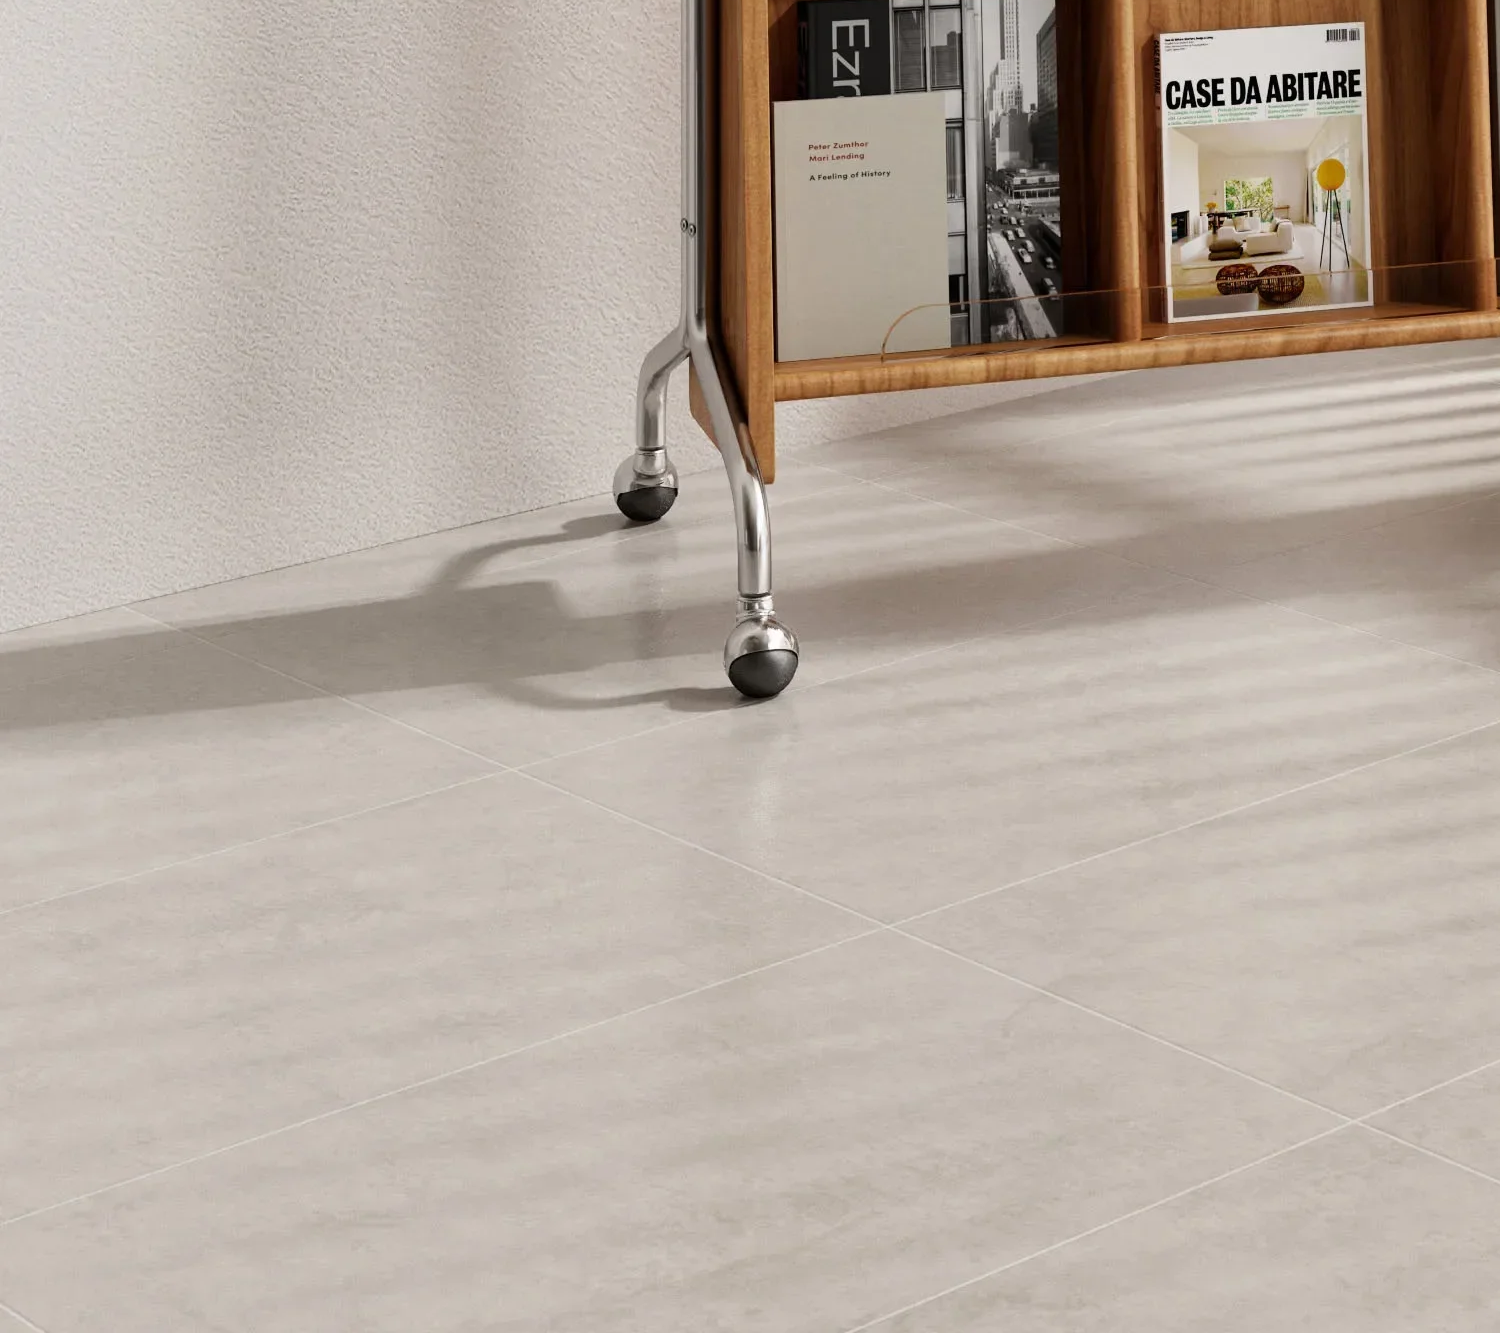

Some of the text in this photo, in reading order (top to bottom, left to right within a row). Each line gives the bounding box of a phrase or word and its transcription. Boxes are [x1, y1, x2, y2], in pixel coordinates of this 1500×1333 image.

[832, 19, 870, 97] Ezr
[1165, 69, 1362, 110] CASE DA ABITARE
[833, 141, 869, 149] Zumthor
[831, 153, 865, 161] Lending
[817, 173, 848, 181] Feeling
[861, 170, 891, 178] History
